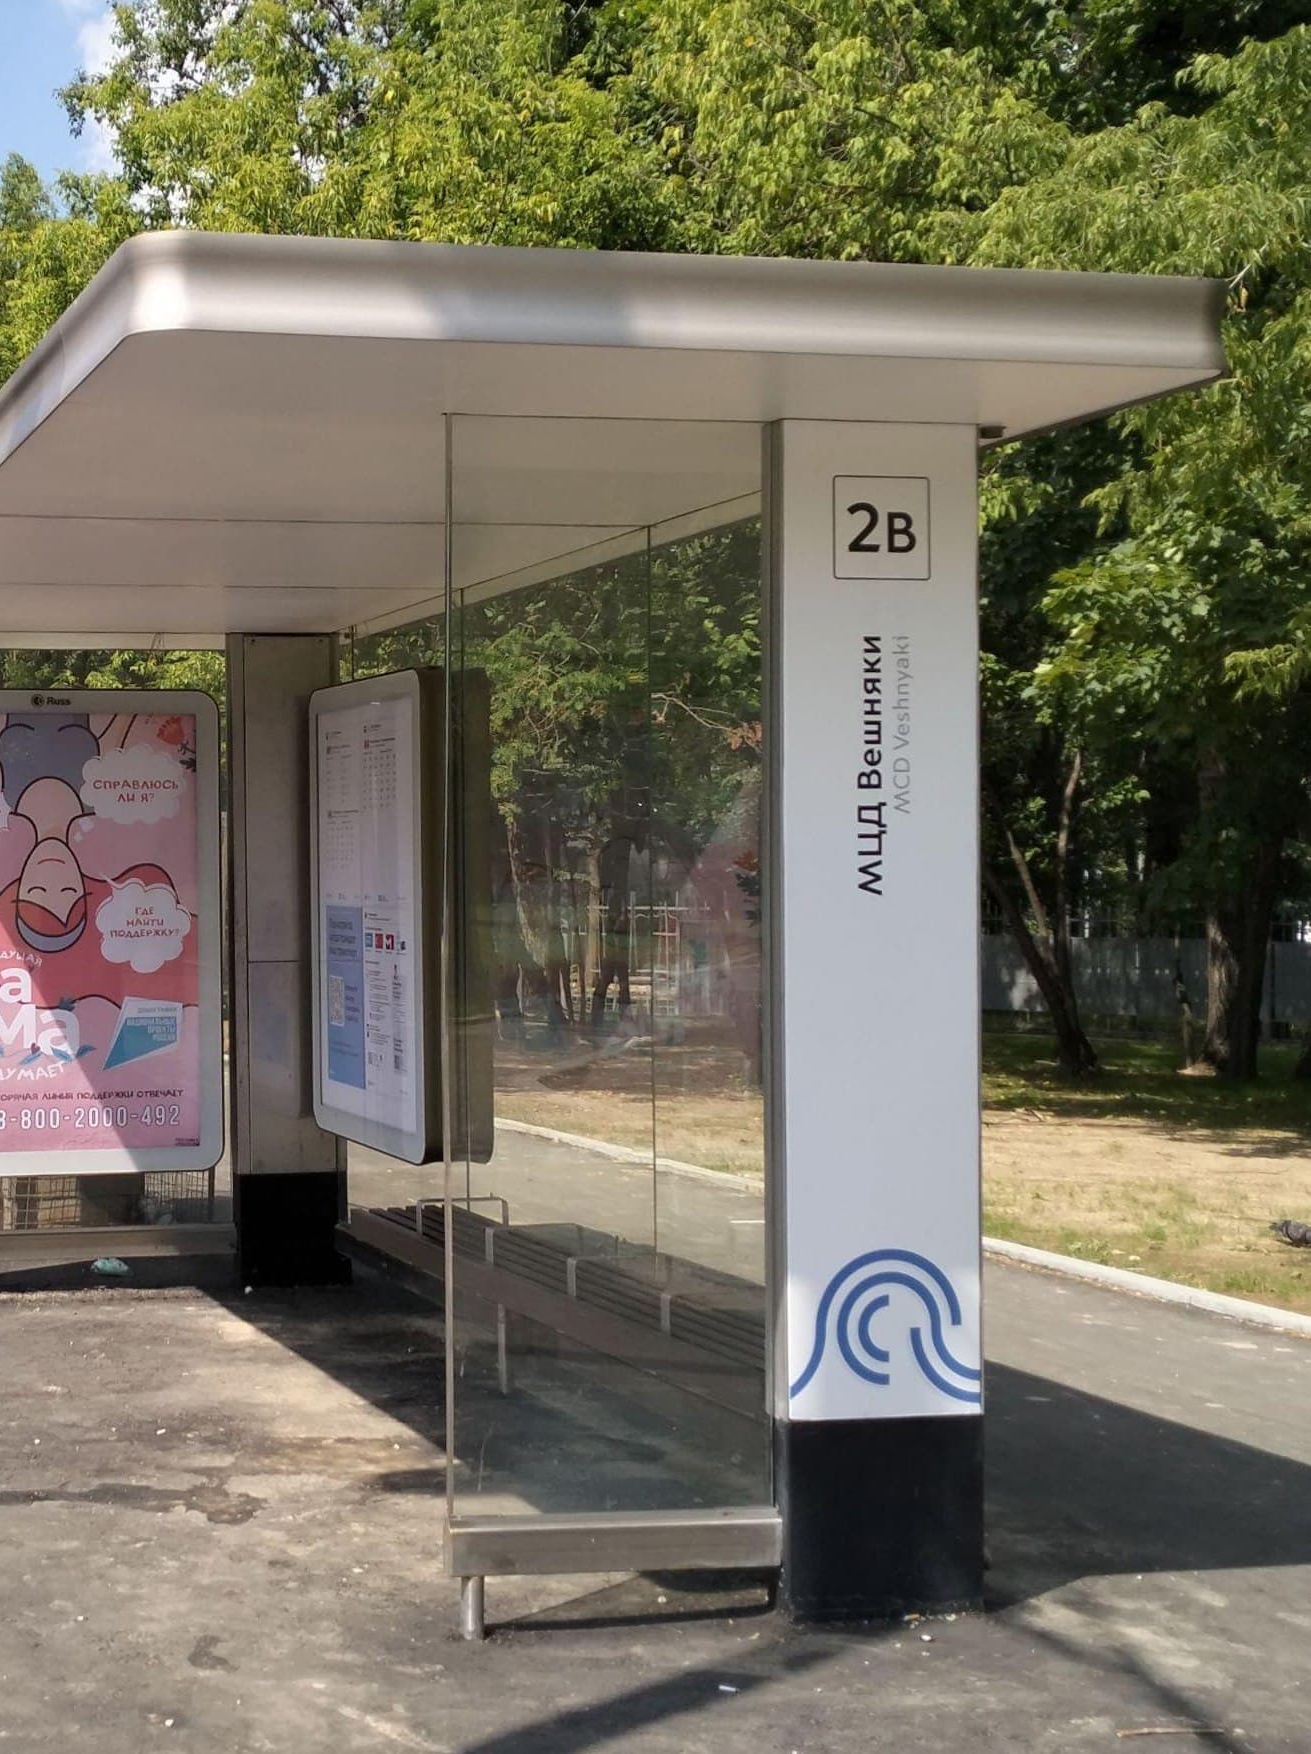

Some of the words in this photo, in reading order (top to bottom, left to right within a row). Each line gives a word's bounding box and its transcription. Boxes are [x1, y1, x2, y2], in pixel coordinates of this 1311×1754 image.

[857, 635, 883, 790] Вешняки
[893, 635, 915, 750] Veshnyaki
[93, 779, 178, 790] СПРАВЛЮСЬ
[117, 792, 135, 803] ЛИ
[141, 792, 155, 803] Я?
[892, 757, 912, 814] MCD
[858, 802, 887, 895] МЦД
